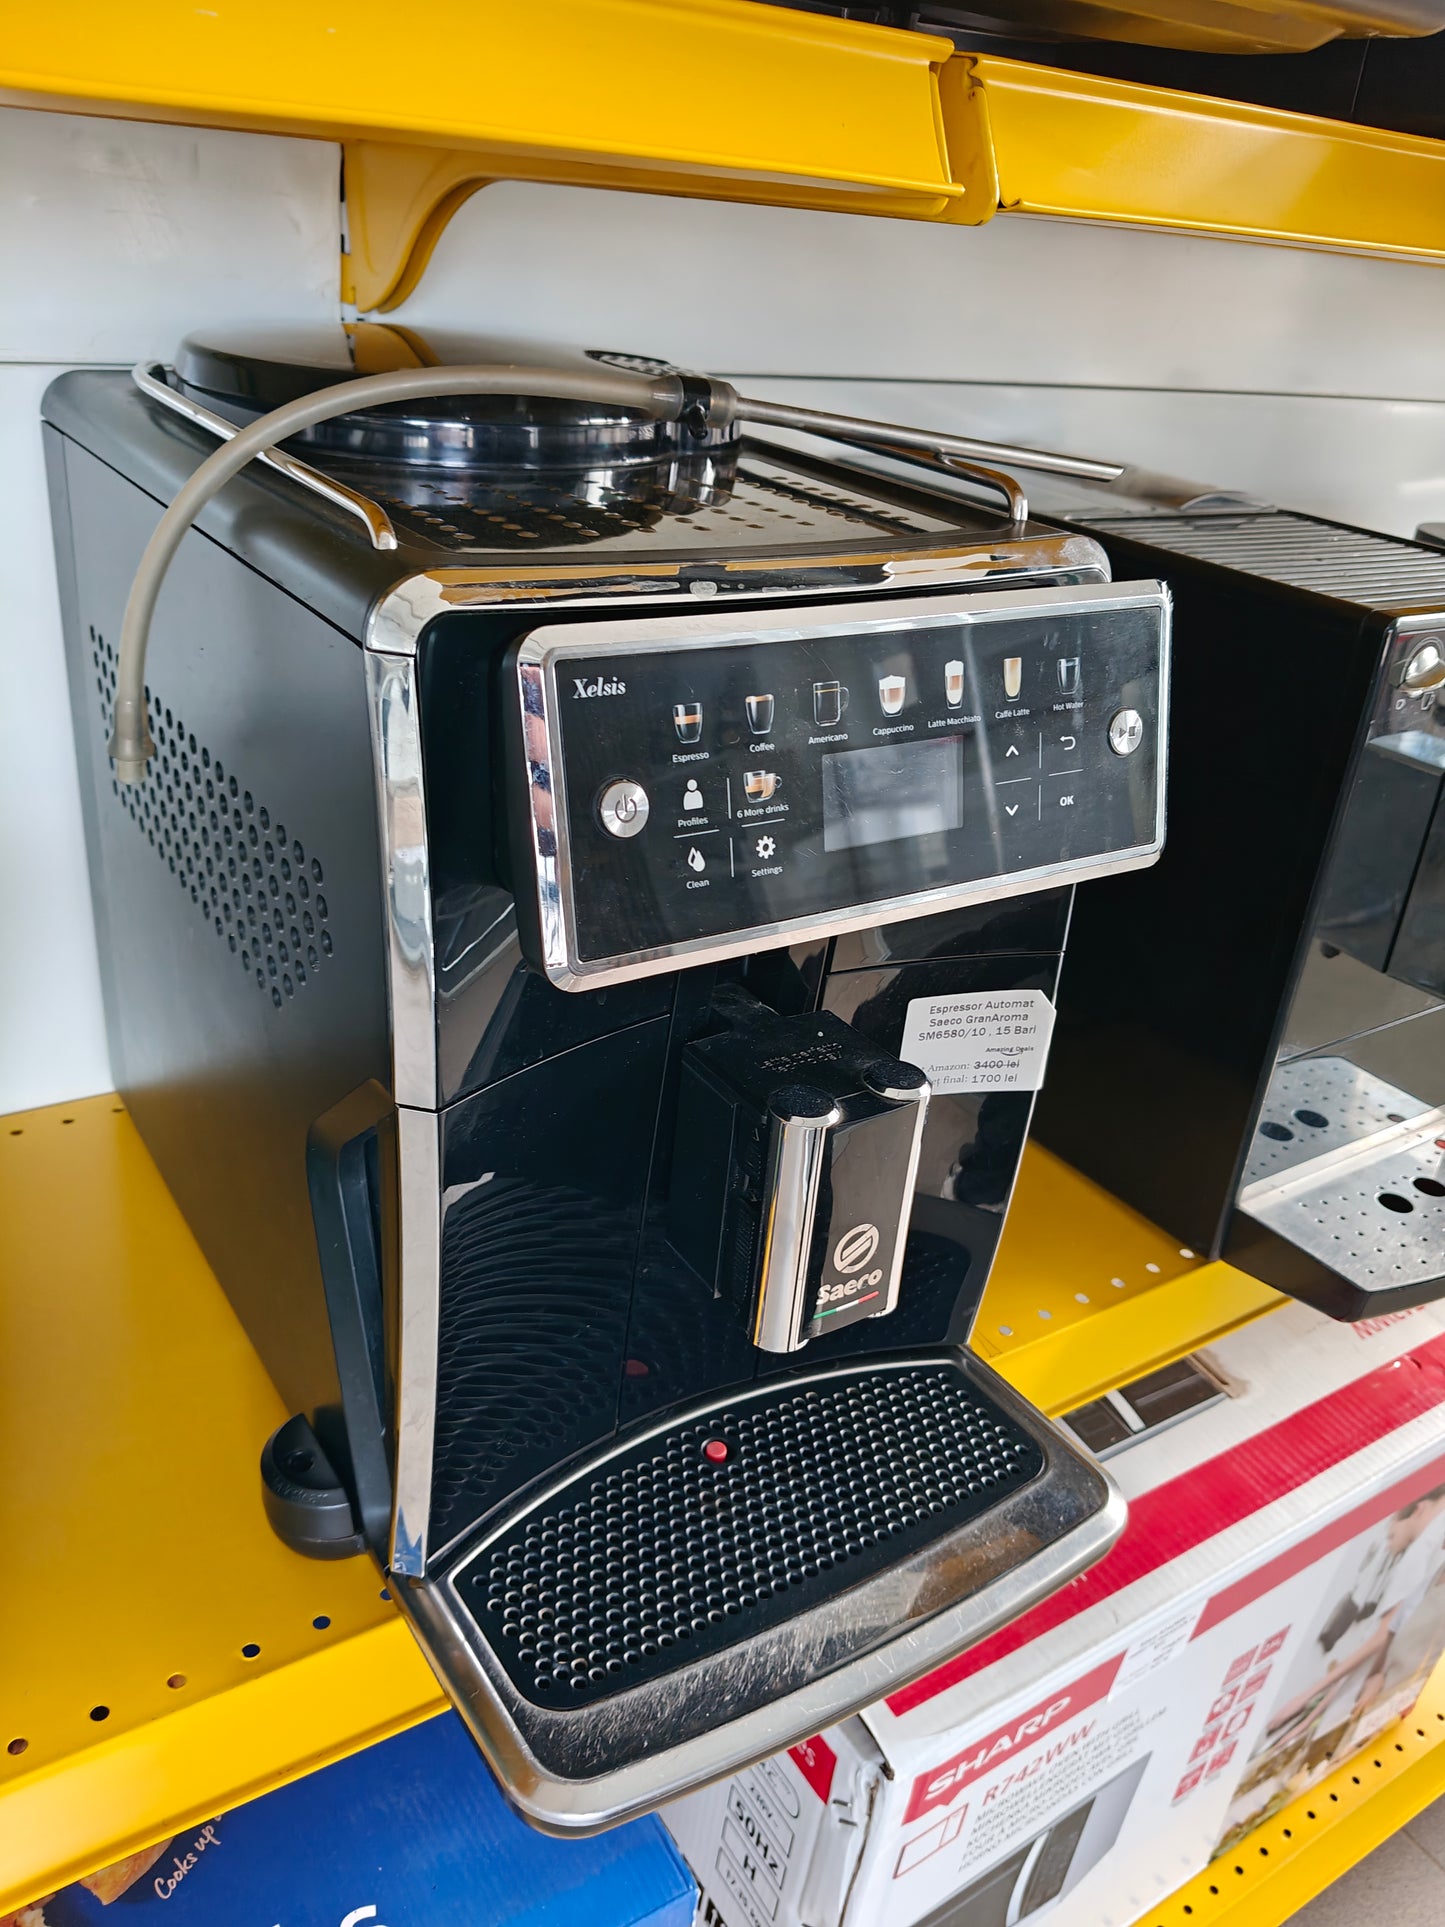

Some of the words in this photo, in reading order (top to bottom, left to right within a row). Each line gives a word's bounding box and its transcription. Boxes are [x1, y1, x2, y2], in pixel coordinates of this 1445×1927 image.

[572, 677, 627, 699] Xelsis
[1012, 707, 1030, 718] Latte
[1053, 703, 1065, 712] Hot
[1066, 700, 1085, 710] Water
[928, 718, 947, 729] Latte
[948, 714, 982, 726] Macchiato
[872, 723, 914, 736] Cappuccino
[808, 732, 848, 745] Americano
[749, 741, 775, 753] Coffee
[672, 750, 710, 764] Espresso
[1059, 795, 1075, 807] OK
[736, 809, 744, 819] 6
[744, 806, 765, 818] More
[765, 803, 790, 815] drinks
[677, 815, 709, 828] Profiles
[751, 865, 784, 878] Settings
[686, 879, 710, 890] Clean
[929, 1002, 983, 1015] Espressor
[985, 999, 1035, 1010] Automat
[929, 1016, 963, 1027] Saeco
[966, 1012, 1029, 1024] GranAroma
[918, 1027, 987, 1041] SM6580/10
[995, 1025, 1011, 1035] 15
[1014, 1025, 1037, 1035] Bari
[927, 1063, 970, 1072] Amazon:
[973, 1060, 1004, 1070] 3400
[1006, 1059, 1020, 1068] lei
[943, 1074, 968, 1084] final:
[971, 1074, 1001, 1083] 1700
[1004, 1073, 1018, 1082] lei
[924, 1696, 1072, 1801] SHARP
[982, 1719, 1097, 1807] R742WW
[153, 1851, 198, 1900] Cooks
[193, 1824, 222, 1852] up
